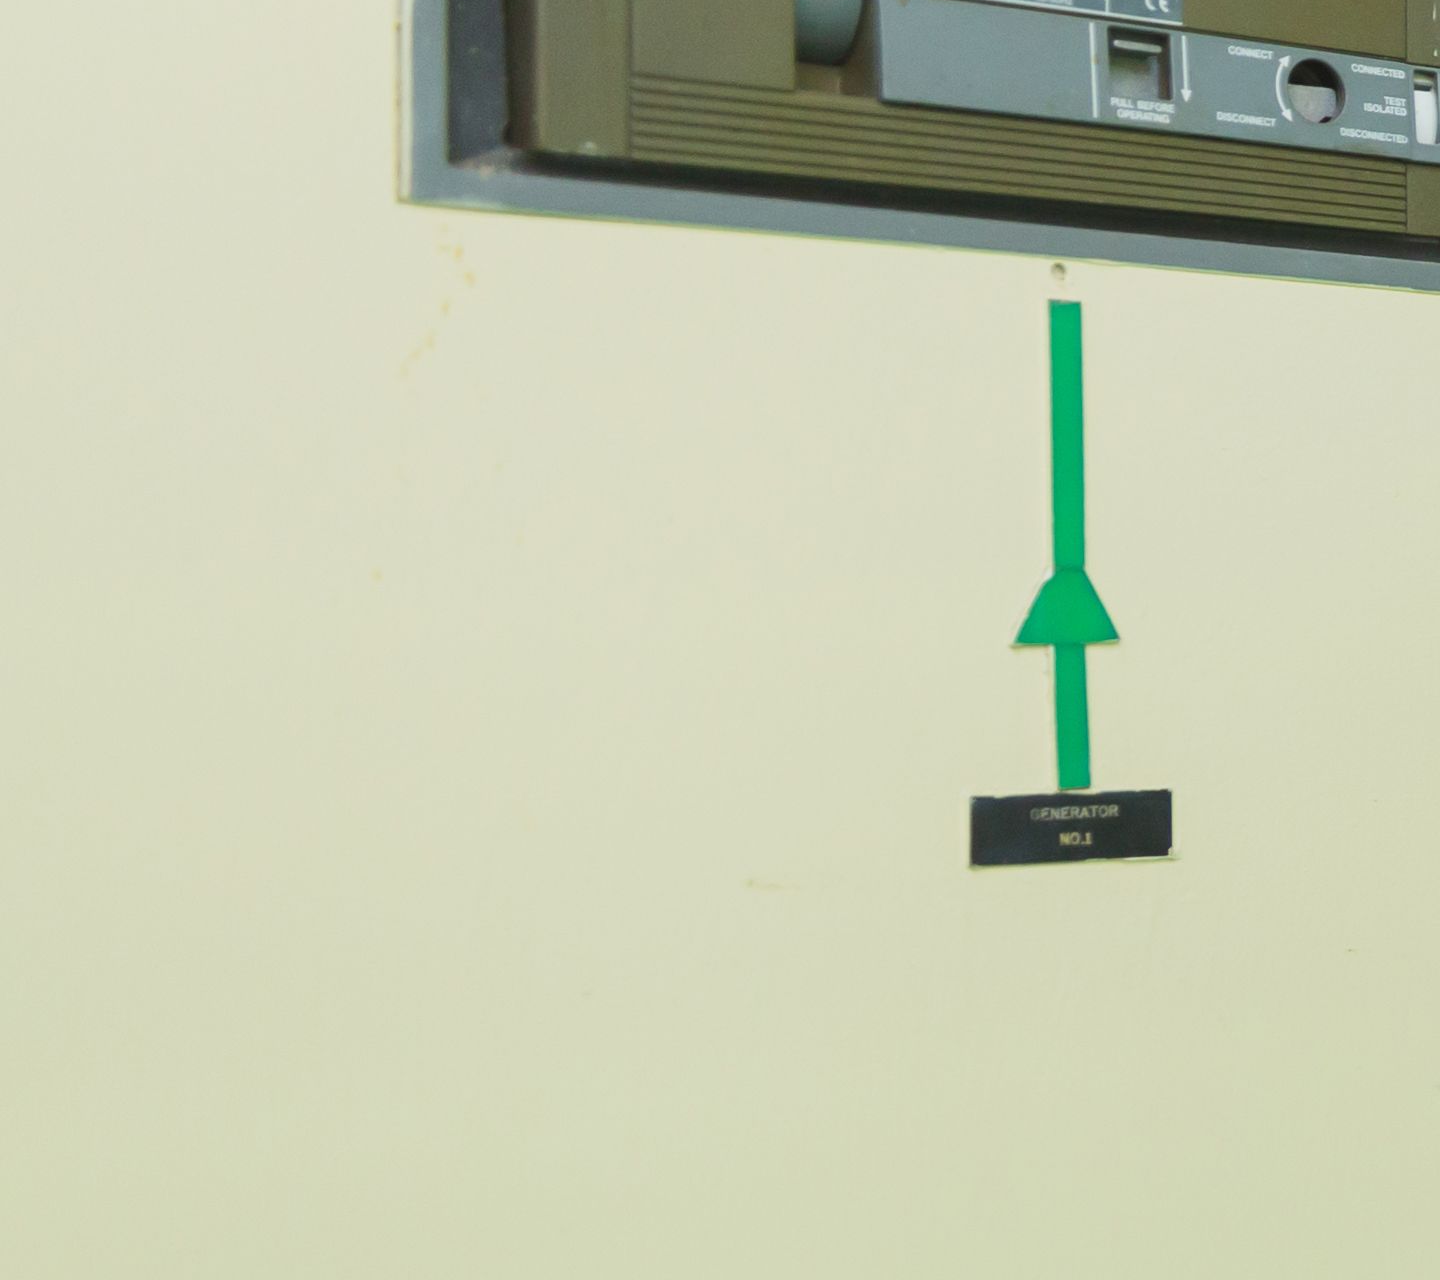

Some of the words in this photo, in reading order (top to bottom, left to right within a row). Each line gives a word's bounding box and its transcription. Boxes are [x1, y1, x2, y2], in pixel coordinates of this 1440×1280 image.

[1227, 45, 1275, 61] CONNECT
[1351, 63, 1406, 79] CONNECTED
[1110, 97, 1135, 109] PULL
[1137, 100, 1176, 113] BEFORE
[1384, 96, 1407, 107] TEST
[1117, 109, 1170, 124] OPERATING
[1363, 103, 1407, 117] ISOLATED
[1216, 111, 1277, 127] DISCONNECT
[1340, 127, 1408, 144] DISCONNECTED
[1030, 804, 1120, 822] GENERATOR
[1058, 831, 1093, 846] NO.1
